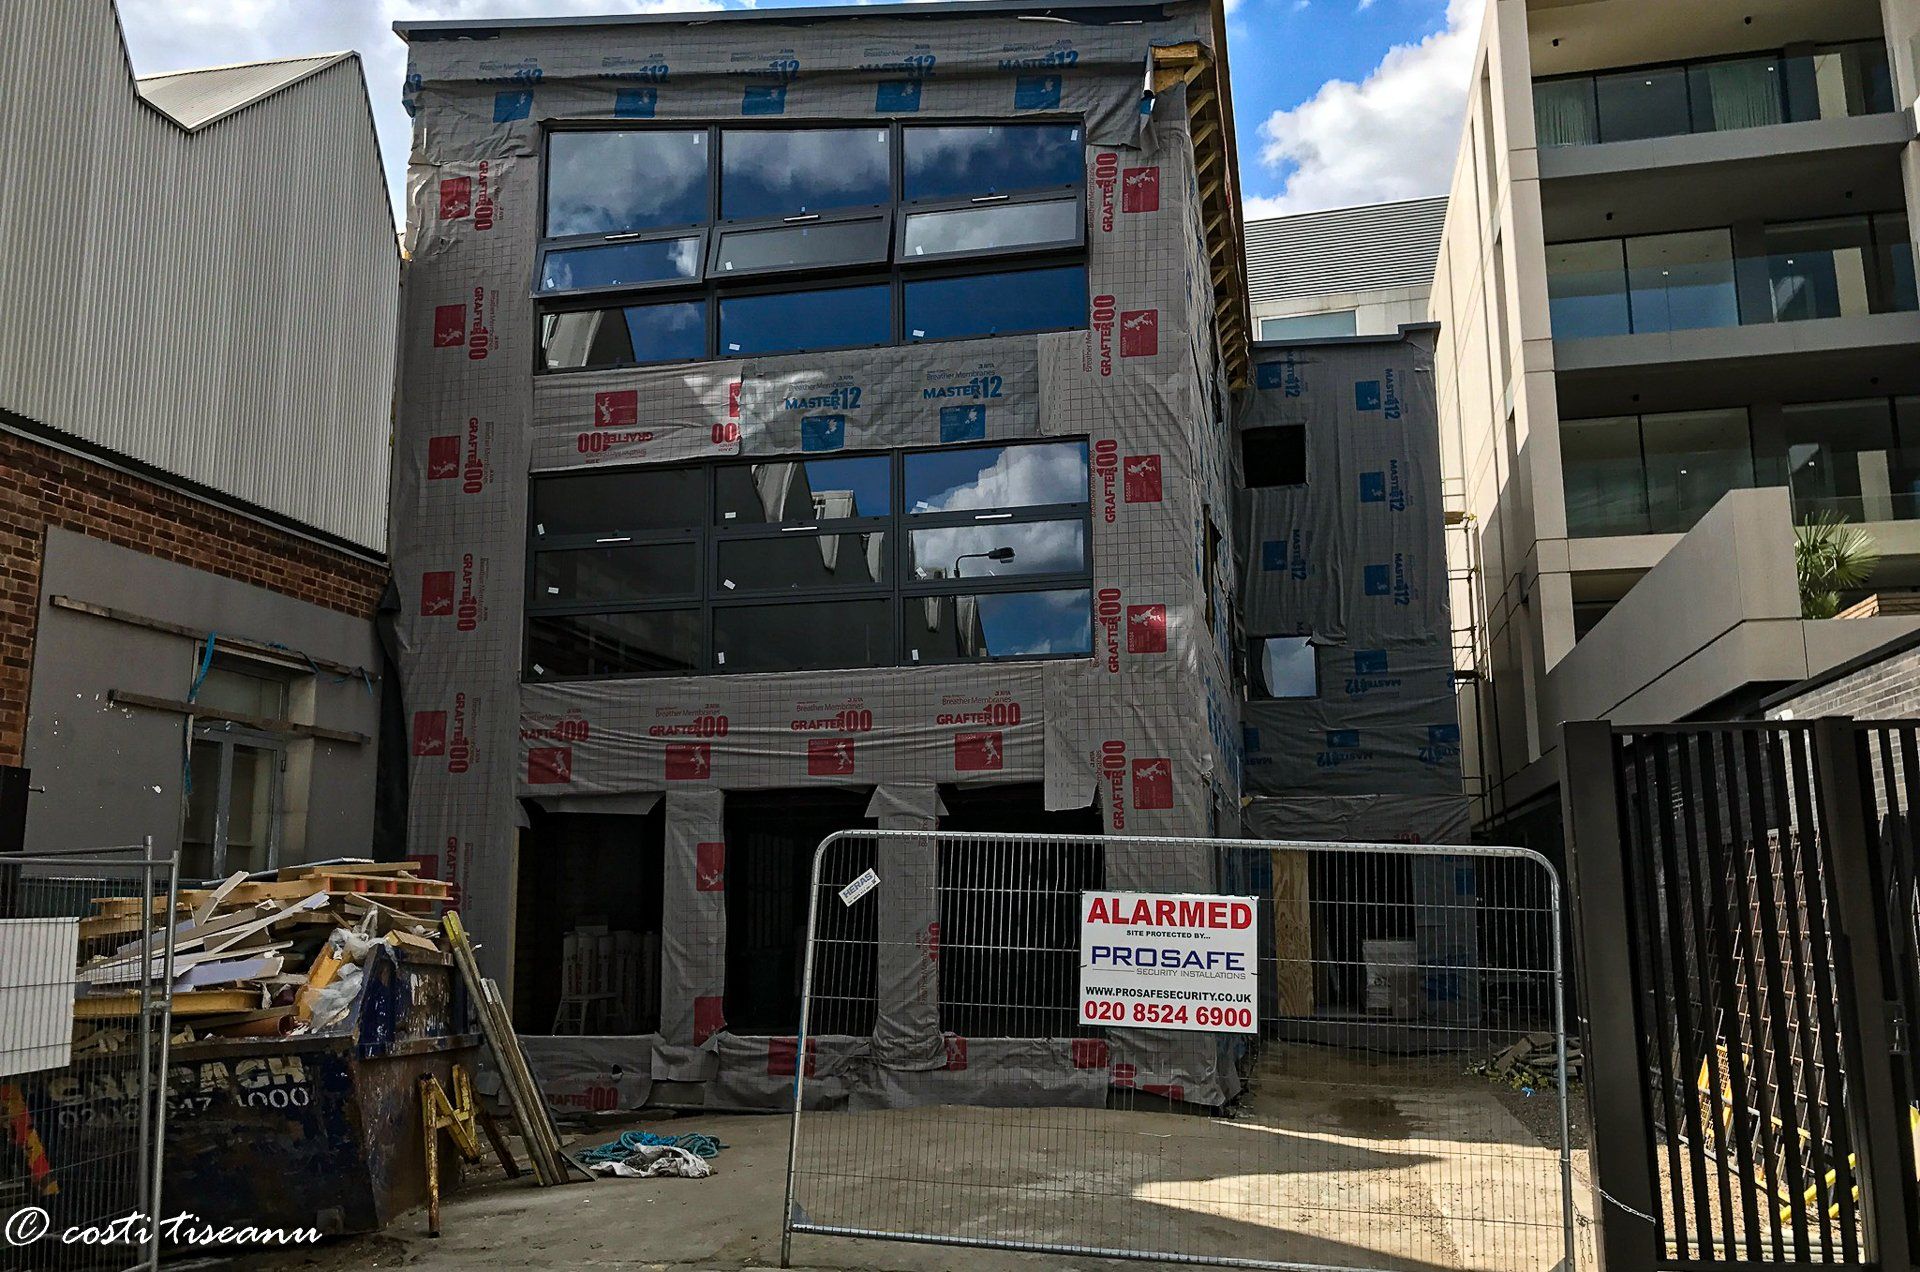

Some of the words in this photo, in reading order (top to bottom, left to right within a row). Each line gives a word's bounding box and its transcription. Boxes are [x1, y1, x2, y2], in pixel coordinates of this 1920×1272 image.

[903, 54, 936, 77] 112
[479, 160, 489, 207] GRAFTER
[1095, 153, 1118, 189] 100
[474, 198, 494, 231] 100
[1102, 180, 1114, 233] GRAFTER
[474, 286, 484, 337] GRAFTER
[1093, 295, 1116, 332] 100
[468, 327, 489, 360] 100
[1100, 324, 1112, 377] GRAFTER
[785, 396, 841, 411] MASTER
[830, 387, 862, 411] 112
[923, 384, 982, 400] MASTER
[969, 375, 1003, 400] 112
[1383, 398, 1401, 420] 112
[468, 416, 479, 467] GRAFTER
[577, 432, 612, 454] 100
[602, 431, 654, 445] GRAFTER
[1095, 440, 1118, 478] 100
[462, 459, 484, 494] 100
[1104, 469, 1116, 524] GRAFTER
[1389, 489, 1406, 512] 112
[463, 553, 473, 604] GRAFTER
[456, 595, 478, 632] 100
[1098, 589, 1122, 627] 100
[1107, 617, 1120, 674] GRAFTER
[454, 691, 466, 744] GRAFTER
[649, 725, 704, 737] GRAFTER
[693, 715, 729, 738] 100
[790, 719, 845, 731] GRAFTER
[836, 709, 873, 732] 100
[936, 711, 993, 726] GRAFTER
[982, 702, 1021, 727] 100
[448, 736, 469, 774] 100
[1102, 740, 1126, 780] 100
[1111, 771, 1125, 830] GRAFTER
[842, 872, 874, 899] HERAS
[1087, 897, 1252, 930] ALARMED
[1146, 931, 1192, 939] PROTECTED
[1091, 945, 1245, 971] PROSAFE
[1136, 968, 1178, 977] SECURITY
[1180, 970, 1246, 980] INSTALLATIONS
[1085, 986, 1252, 1003] WWW.PROSAFESECURITY.CO.UK
[1085, 1000, 1126, 1021] 020
[1133, 1003, 1188, 1024] 8524
[1195, 1006, 1252, 1028] 6900
[583, 1085, 619, 1111] 100
